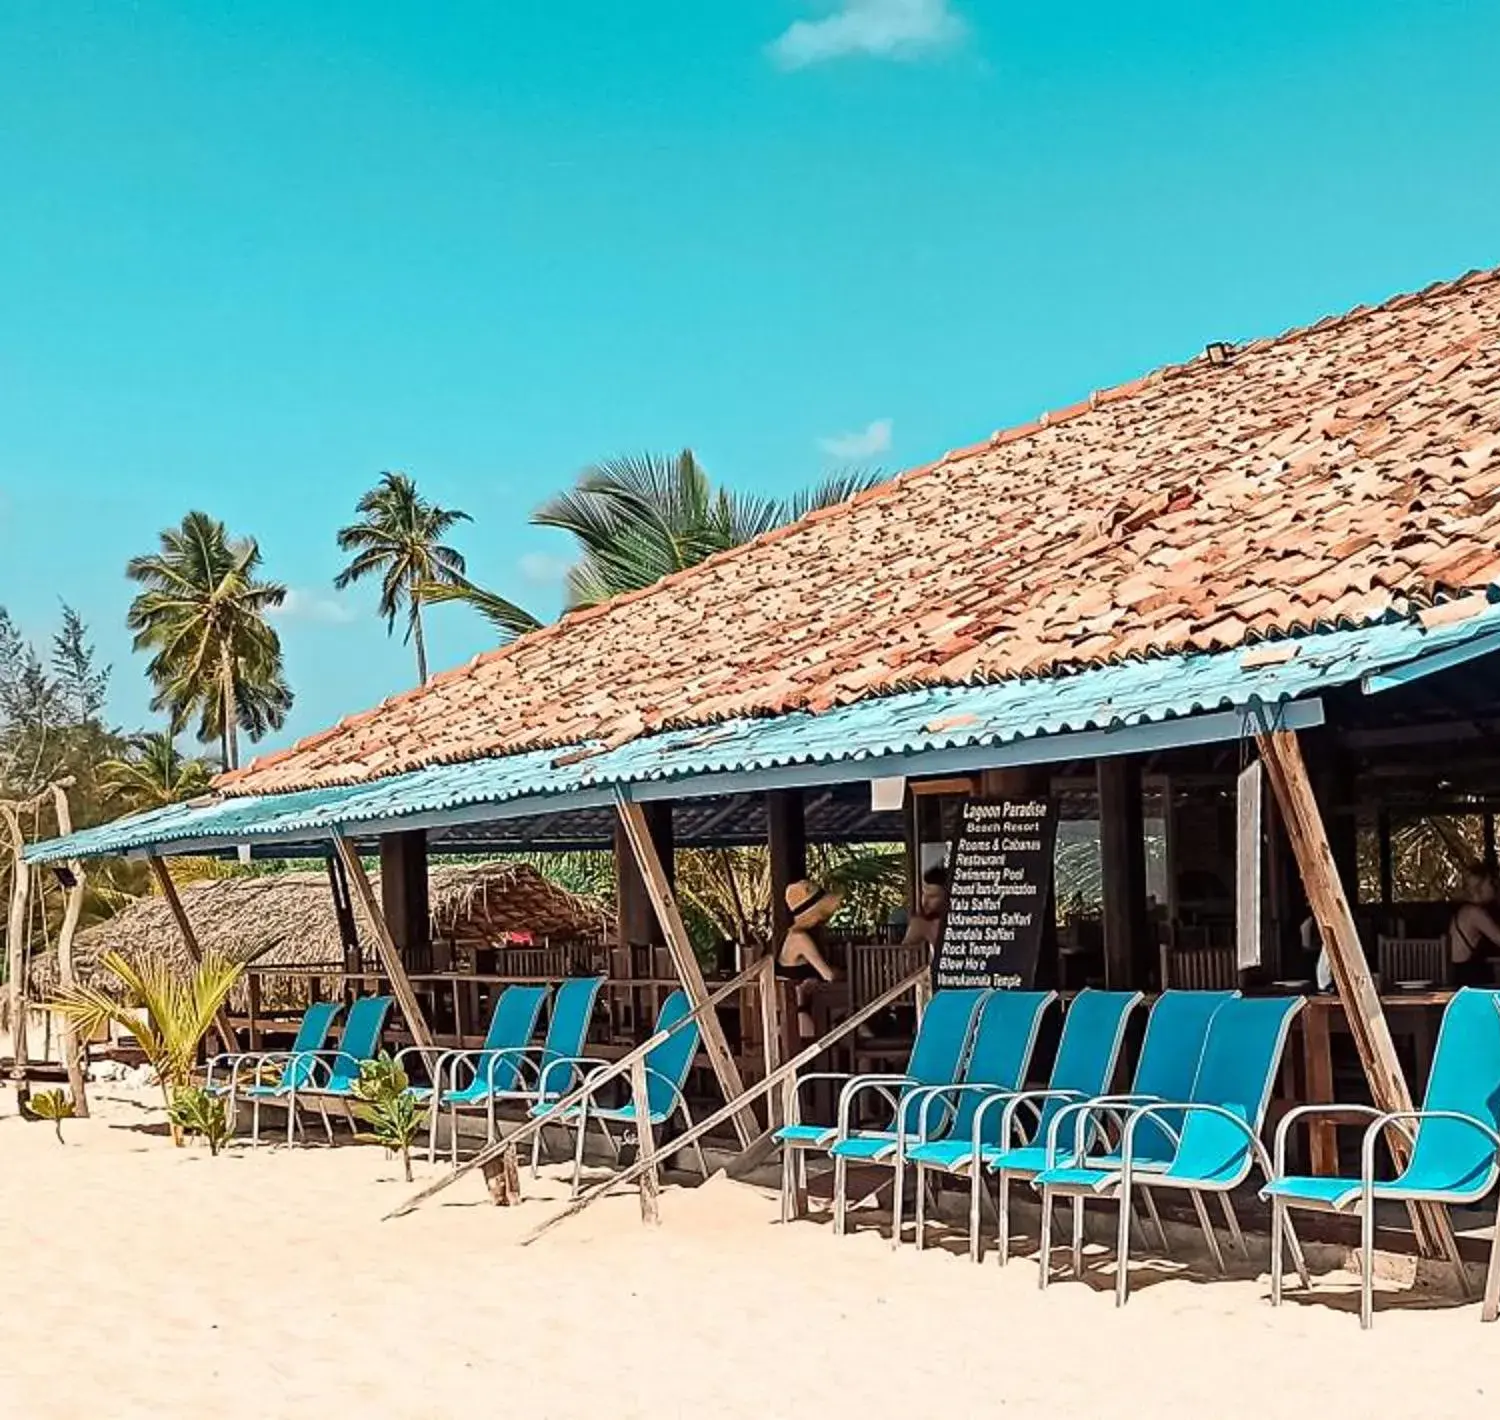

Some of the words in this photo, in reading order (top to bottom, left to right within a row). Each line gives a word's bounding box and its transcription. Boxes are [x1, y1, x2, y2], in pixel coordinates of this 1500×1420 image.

[963, 801, 1001, 822] Lagoon
[1002, 800, 1047, 818] Paradise
[966, 821, 1001, 833] Beach
[1002, 821, 1040, 833] Resort
[1002, 867, 1025, 881] Pool
[968, 942, 1001, 959] Temple
